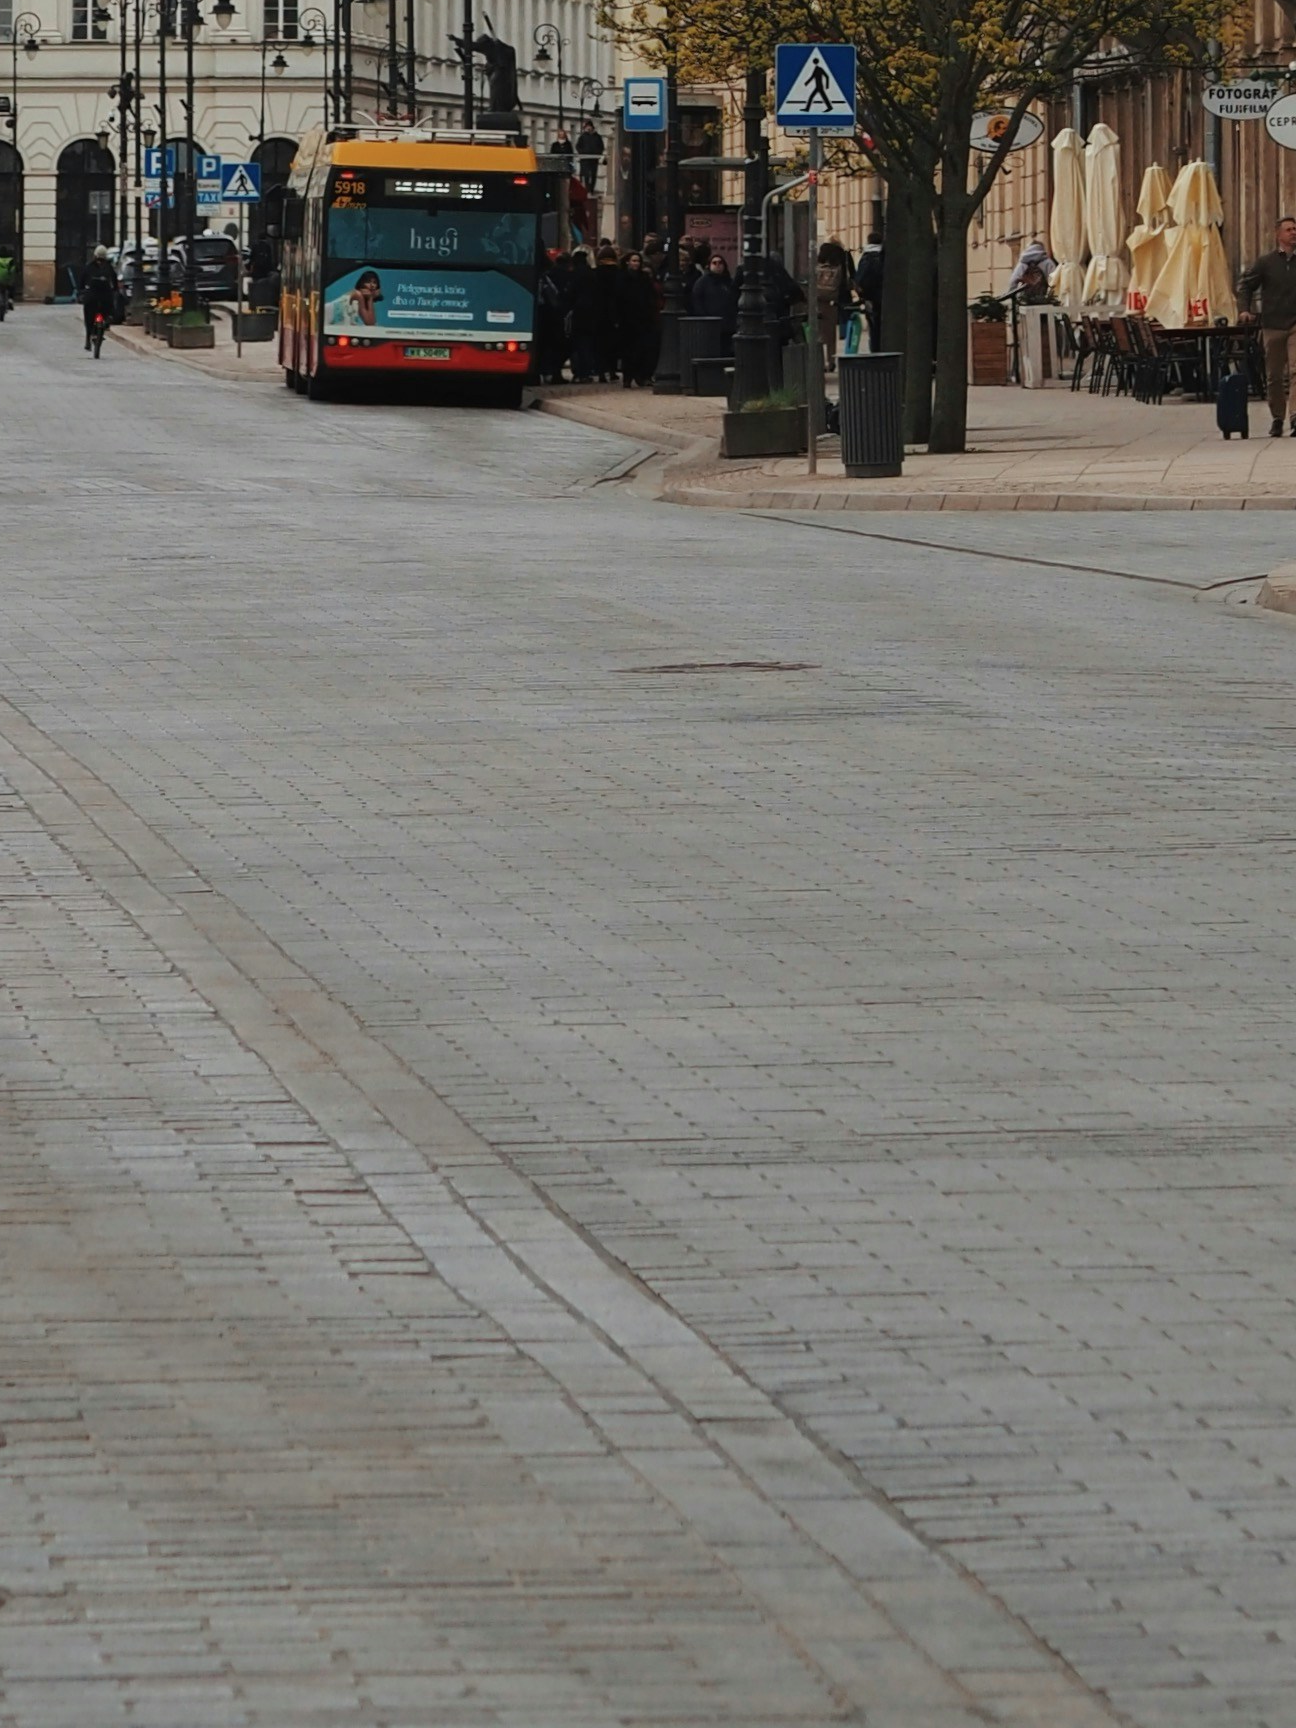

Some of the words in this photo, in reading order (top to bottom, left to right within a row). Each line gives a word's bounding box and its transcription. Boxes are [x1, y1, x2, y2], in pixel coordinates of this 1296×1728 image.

[1209, 88, 1279, 100] FOTOGRAF
[1219, 104, 1268, 114] FUJIFILM
[202, 157, 217, 178] P
[334, 180, 366, 195] 5918
[199, 192, 221, 203] TAXI
[410, 227, 459, 256] hagi
